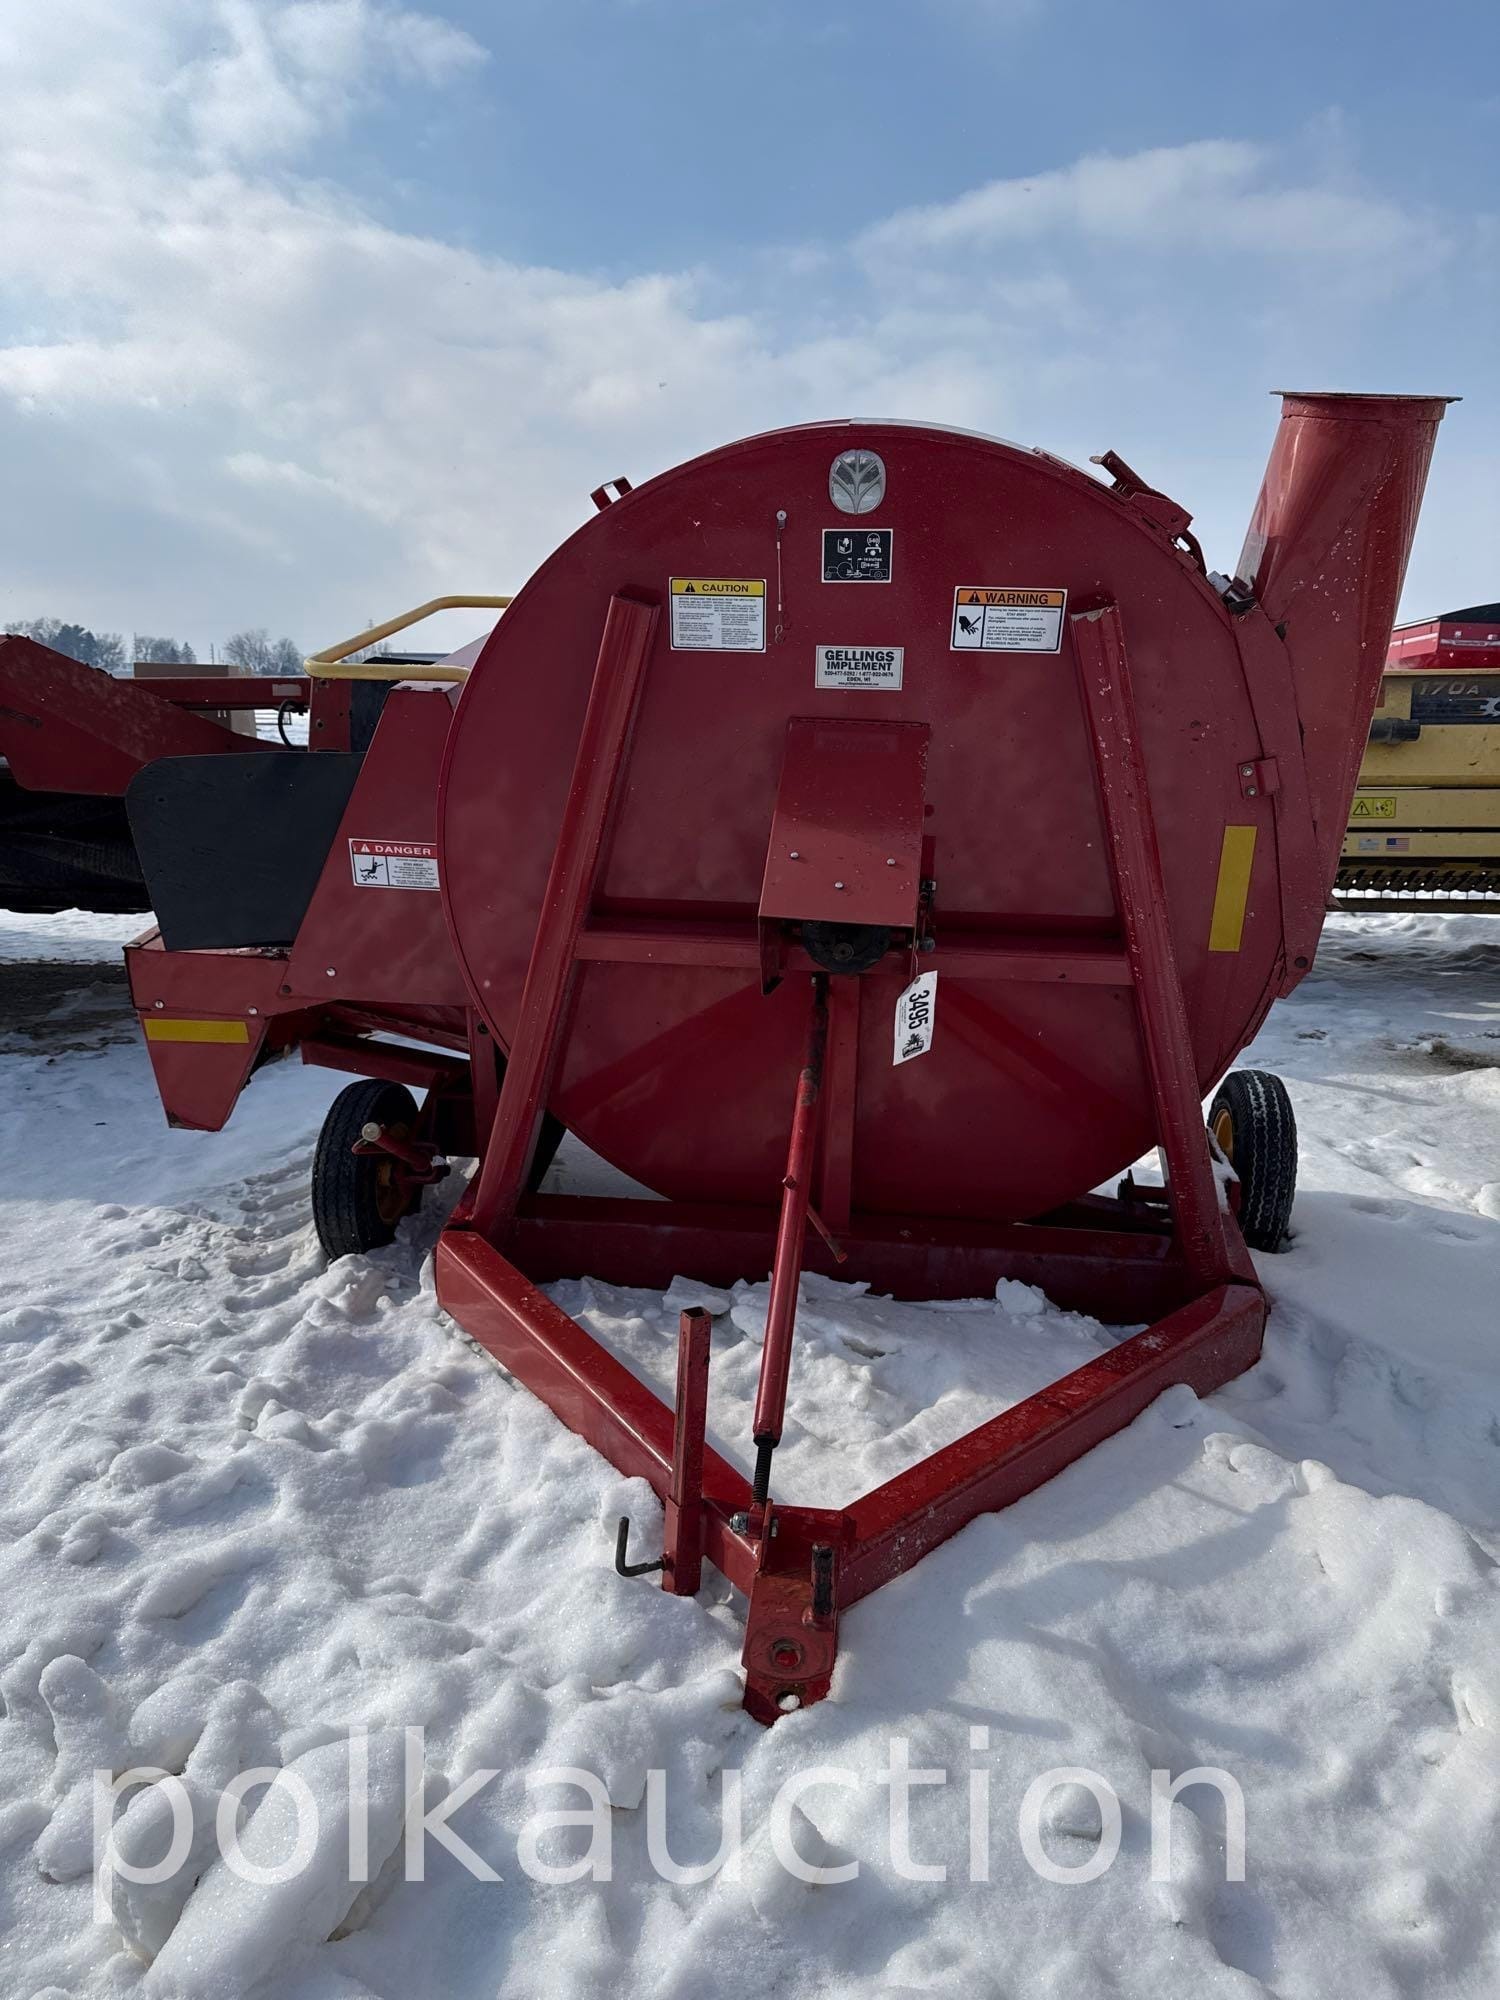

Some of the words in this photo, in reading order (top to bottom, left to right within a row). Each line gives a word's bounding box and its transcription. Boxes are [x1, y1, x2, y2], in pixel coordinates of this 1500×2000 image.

[702, 583, 749, 593] CAUTION
[985, 592, 1049, 605] WARNING
[824, 650, 895, 662] GELLINGS
[827, 661, 893, 671] IMPLEMENT
[374, 845, 431, 855] DANGER
[908, 989, 930, 1030] 3495
